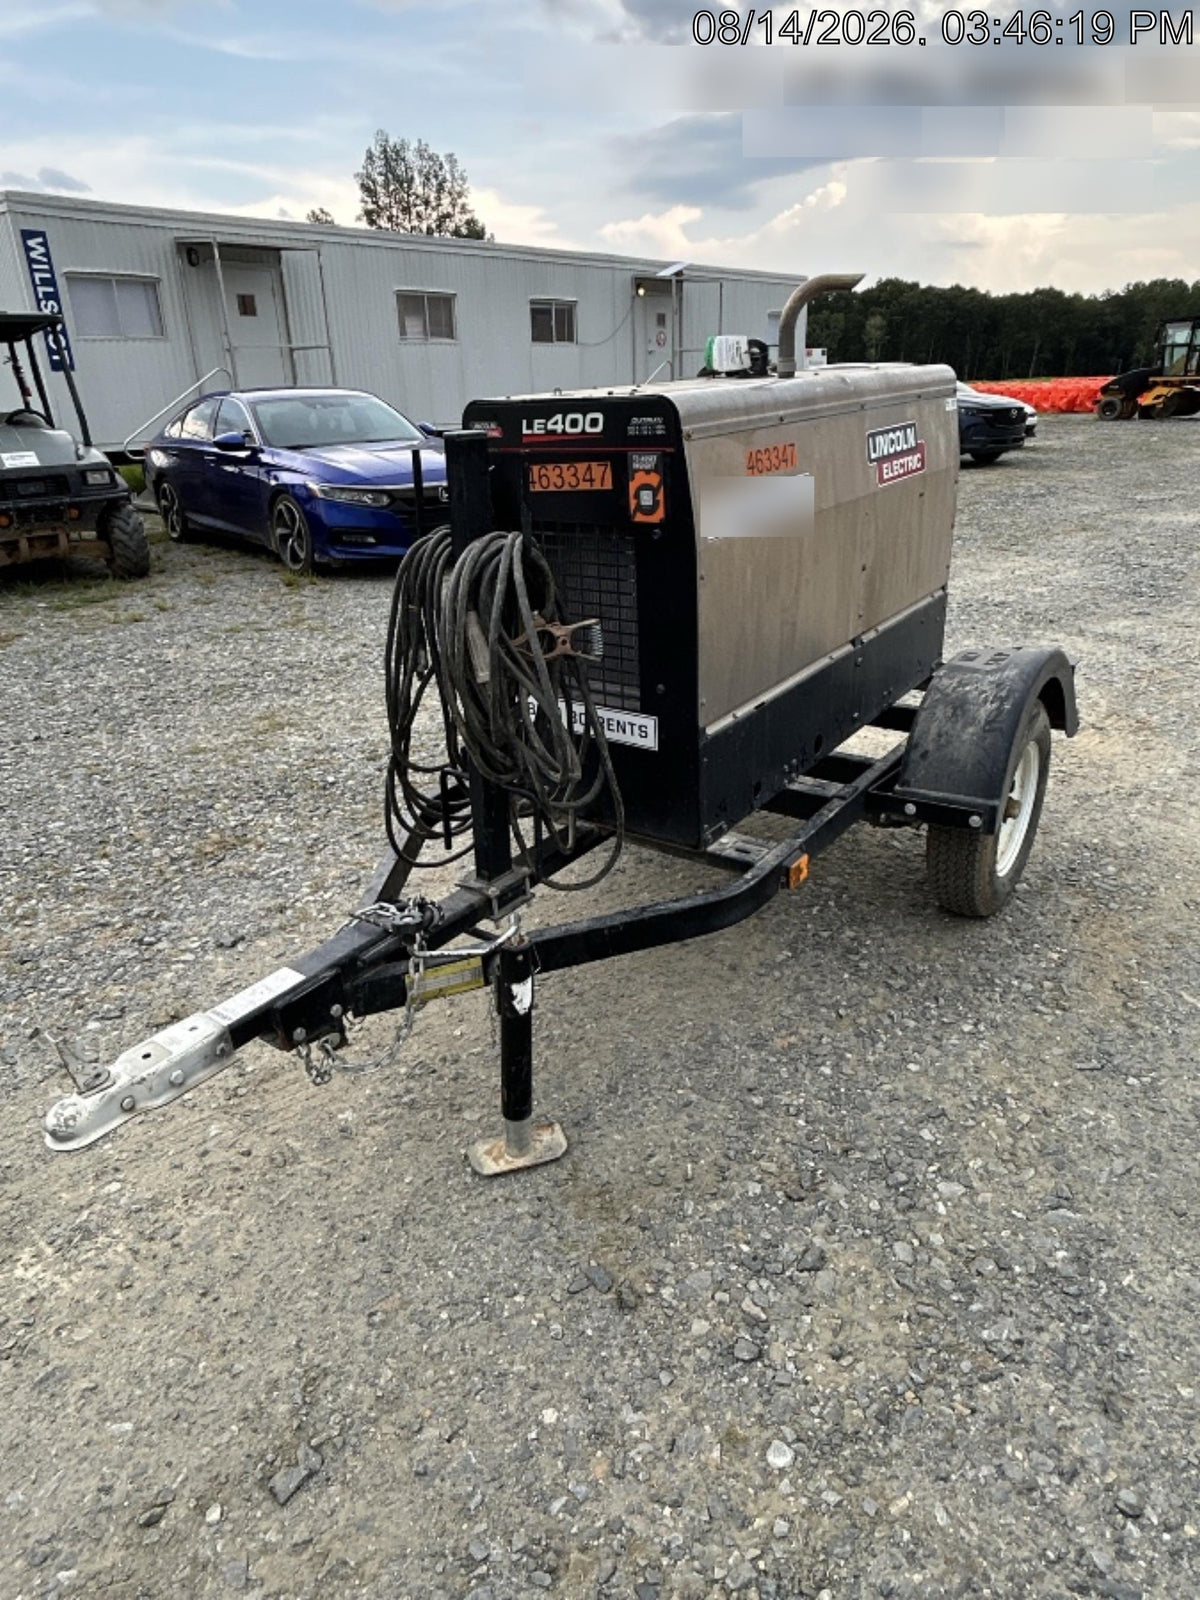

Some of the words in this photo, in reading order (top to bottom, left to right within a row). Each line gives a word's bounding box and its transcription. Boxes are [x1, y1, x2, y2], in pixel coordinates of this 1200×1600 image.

[522, 412, 604, 435] LE400
[869, 427, 916, 459] LINCOLN
[746, 444, 795, 475] 463347
[883, 454, 922, 479] ELECTRIC
